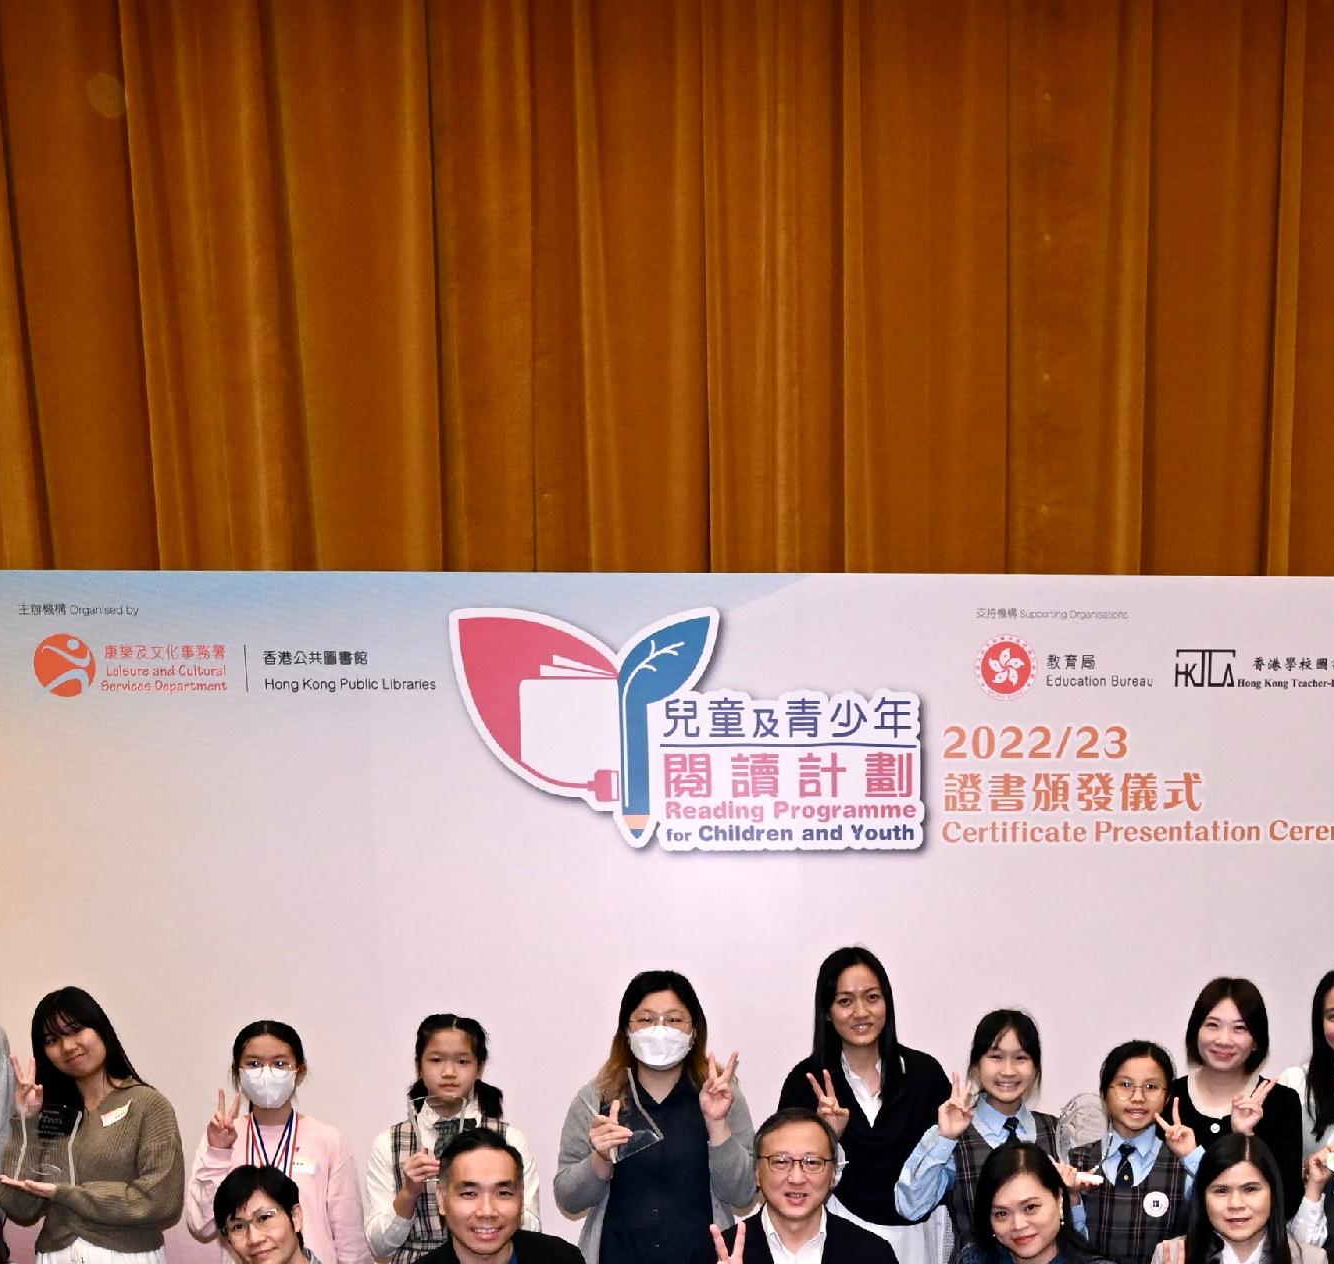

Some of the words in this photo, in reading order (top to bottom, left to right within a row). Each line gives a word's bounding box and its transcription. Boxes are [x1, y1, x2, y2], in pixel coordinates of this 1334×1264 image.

[69, 604, 123, 617] Organised
[126, 604, 139, 617] by
[1019, 609, 1067, 620] Supporting
[1069, 610, 1128, 620] Organisations
[105, 644, 226, 660] 康樂及文化事務署
[262, 650, 368, 666] 香港公共圖書館
[1047, 654, 1096, 670] 教育局
[106, 665, 149, 677] Leisure
[152, 665, 175, 677] and
[178, 664, 227, 677] Cultural
[100, 680, 152, 692] Services
[155, 680, 228, 695] Department
[265, 678, 299, 692] Hong
[302, 678, 336, 692] Kong
[340, 678, 379, 690] Public
[383, 678, 437, 690] Libraries
[1046, 675, 1107, 687] Education
[1111, 675, 1154, 687] Bureau
[1237, 679, 1262, 689] Hong
[1264, 679, 1289, 689] Kong
[662, 696, 913, 738] 兒童及青少年
[941, 725, 1129, 760] 2022/23
[663, 752, 914, 798] 閱讀計劃
[943, 771, 1203, 812] 證書頒發儀式
[665, 800, 764, 824] Reading
[772, 801, 917, 824] Programme
[666, 828, 692, 842] for
[698, 824, 793, 842] Children
[802, 824, 843, 841] and
[851, 824, 915, 841] Youth
[942, 820, 1087, 844] Certificate
[1095, 821, 1262, 844] Presentation
